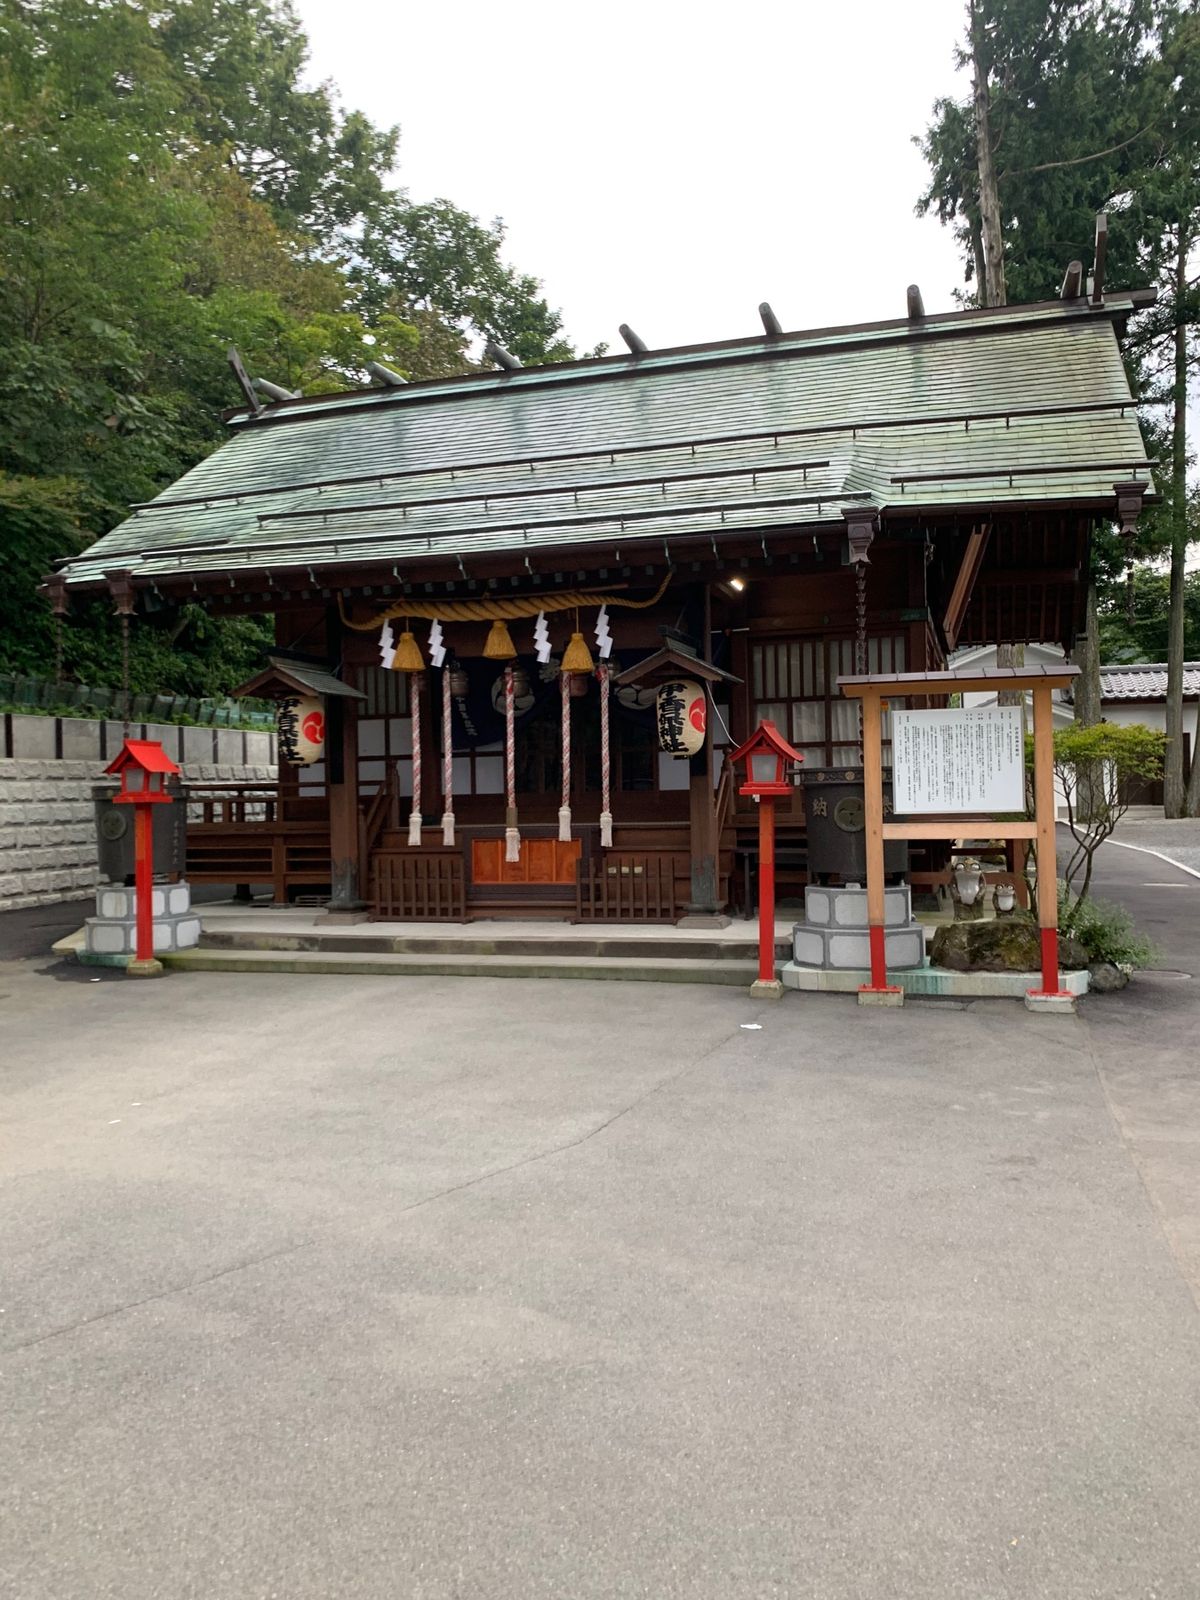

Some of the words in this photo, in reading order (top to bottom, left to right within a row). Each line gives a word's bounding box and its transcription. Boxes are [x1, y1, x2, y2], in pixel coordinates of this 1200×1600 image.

[658, 683, 689, 753] 伊香保神社
[812, 796, 828, 817] 納
